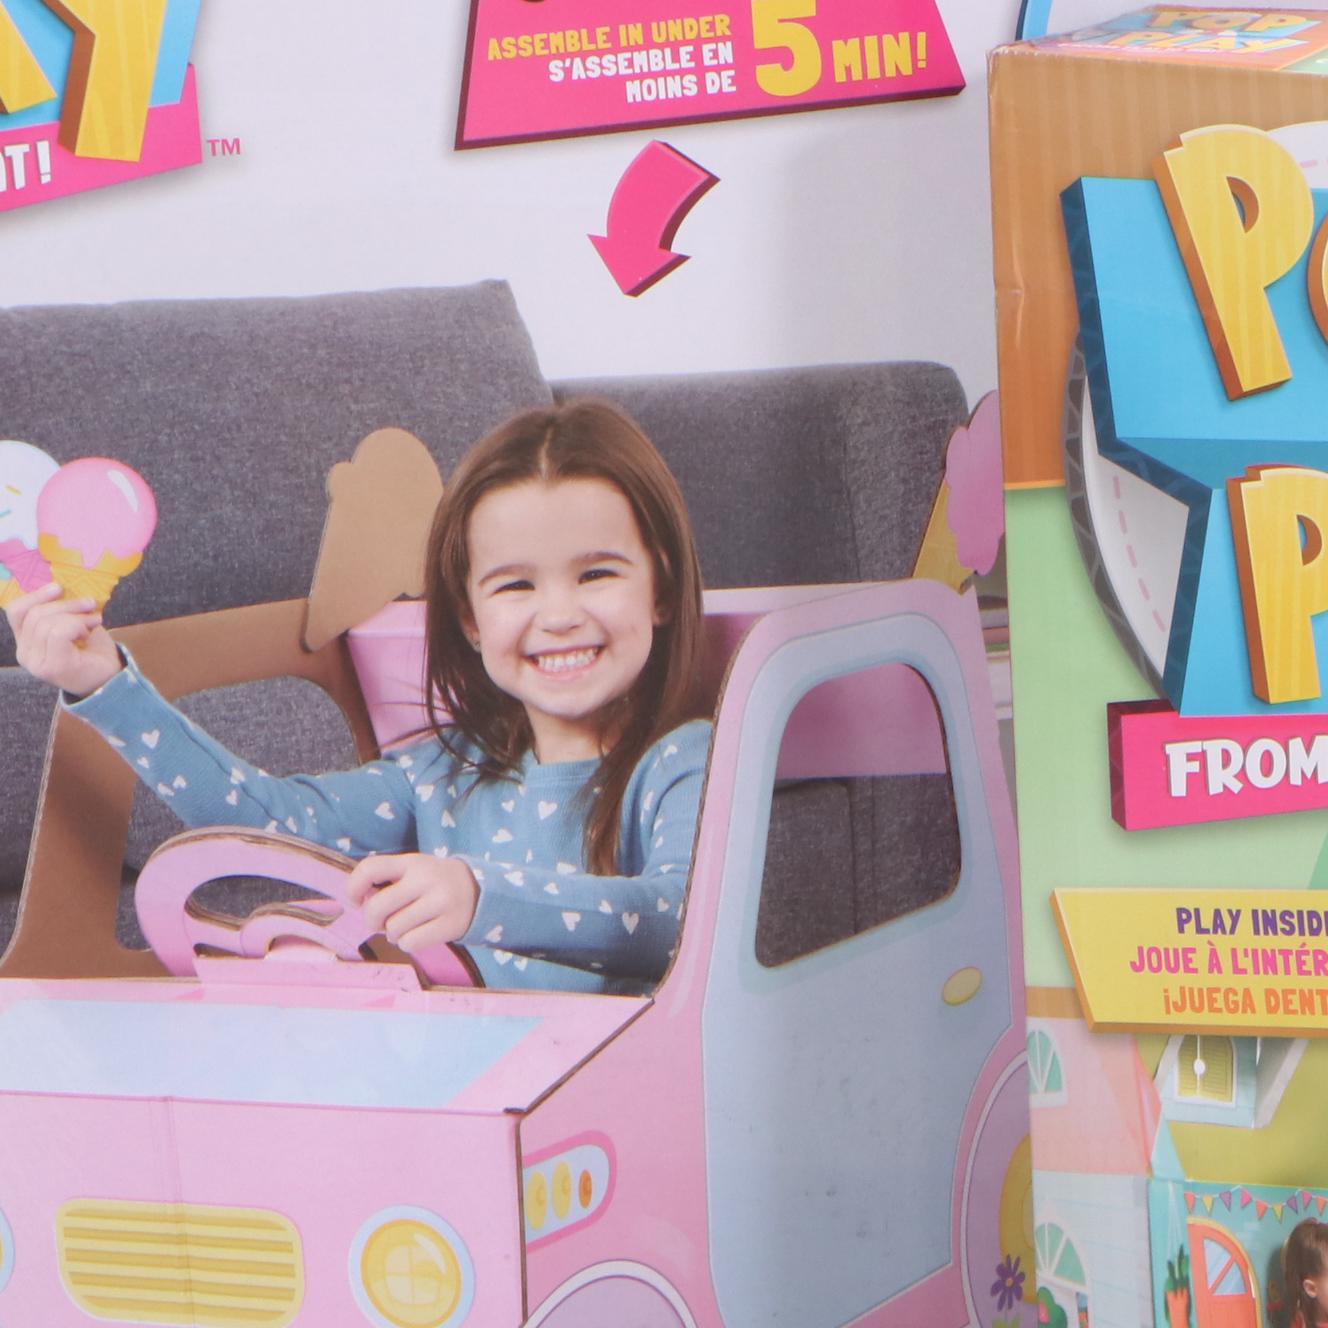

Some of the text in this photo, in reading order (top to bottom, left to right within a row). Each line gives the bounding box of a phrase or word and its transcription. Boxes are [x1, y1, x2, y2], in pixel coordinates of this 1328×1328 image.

[488, 14, 732, 62] ASSEMBLE IN UNDER
[1150, 11, 1308, 31] POP
[548, 41, 734, 83] S'ASSEMBLE EN
[754, 0, 929, 97] 5 MIN!
[626, 69, 738, 103] MOINS DE
[1175, 907, 1241, 935] PLAY
[1129, 946, 1198, 974] JOUE
[1208, 941, 1223, 976] À
[1164, 986, 1256, 1016] ¡JUEGA
